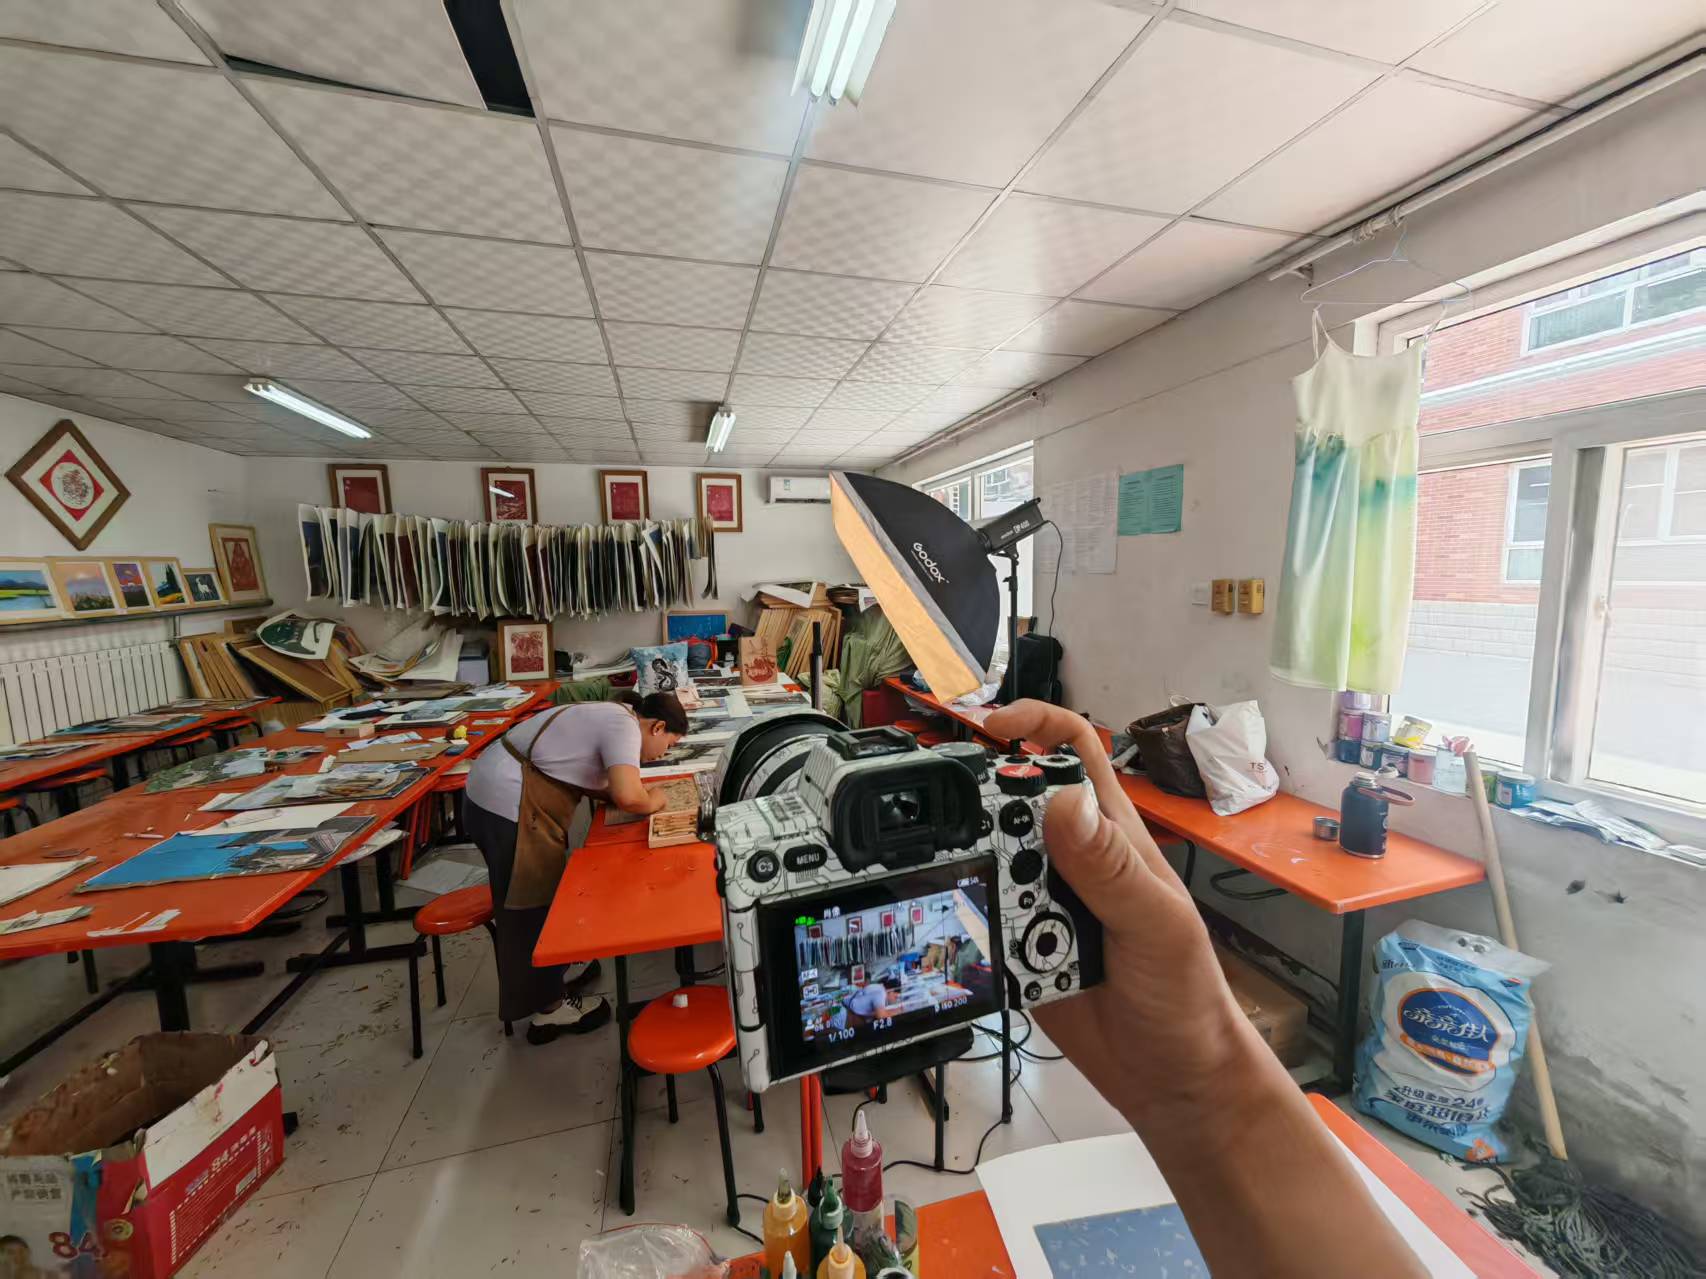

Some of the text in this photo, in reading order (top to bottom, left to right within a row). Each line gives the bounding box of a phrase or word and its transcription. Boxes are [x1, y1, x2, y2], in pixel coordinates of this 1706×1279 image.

[913, 542, 945, 583] Godox
[796, 853, 820, 865] MENU
[873, 1017, 893, 1030] F2.8
[828, 1027, 855, 1043] 1/100
